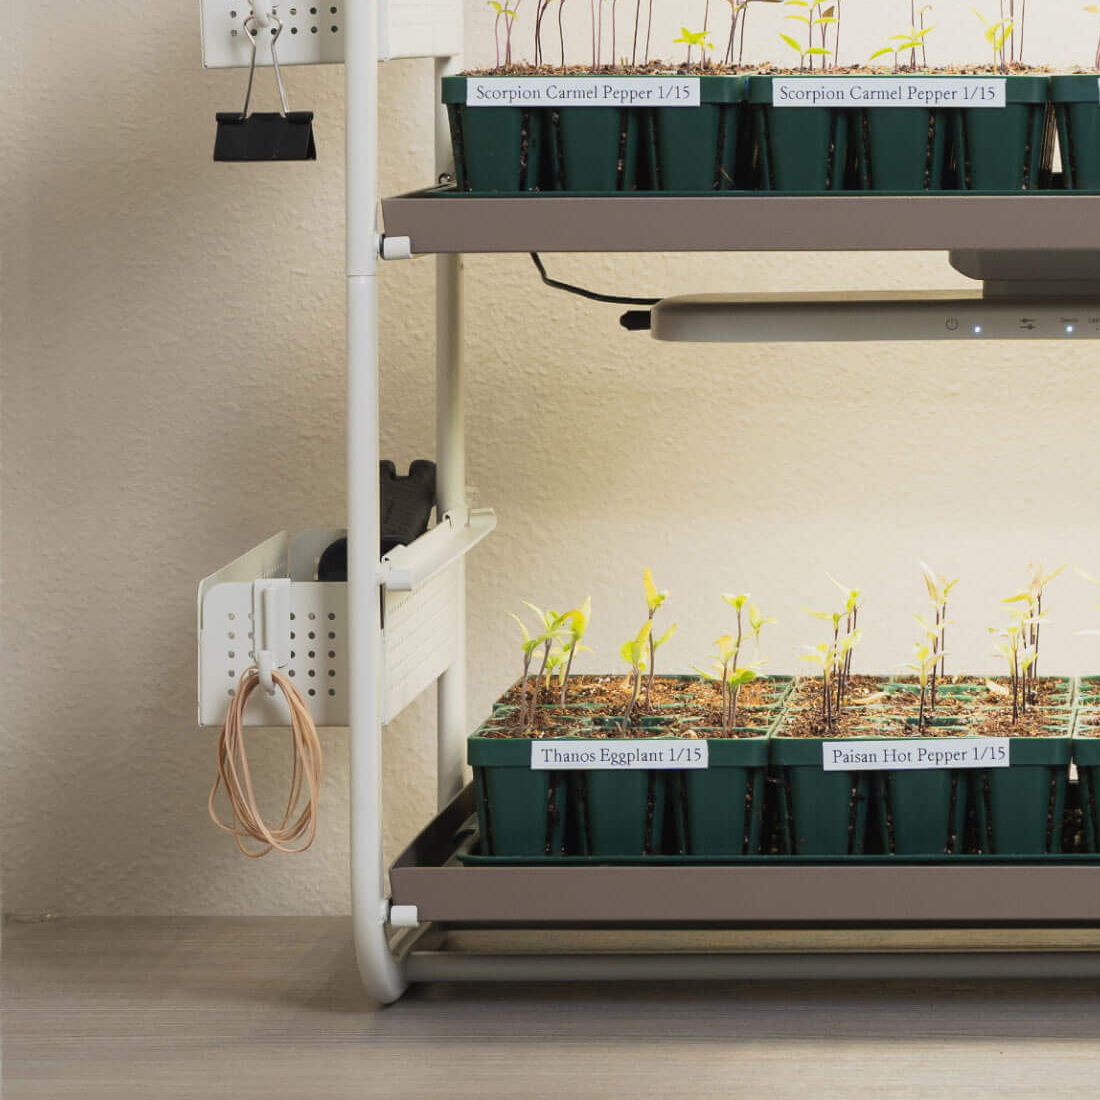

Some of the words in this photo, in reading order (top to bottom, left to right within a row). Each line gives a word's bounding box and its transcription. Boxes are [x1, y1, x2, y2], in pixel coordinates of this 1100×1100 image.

[476, 85, 541, 104] Scorpion
[545, 84, 598, 100] Carmel
[602, 85, 653, 104] Pepper
[658, 85, 690, 100] 1/15
[780, 85, 845, 105] Scorpion
[849, 85, 902, 100] Carmel
[907, 85, 958, 104] Pepper
[963, 86, 996, 100] 1/15
[540, 747, 596, 763] Thanos
[599, 747, 664, 766] Eggplant
[669, 747, 702, 762] 1/15
[832, 749, 878, 764] Paisan
[883, 748, 912, 763] Hot
[917, 747, 968, 765] Pepper
[972, 746, 1006, 761] 1/15
